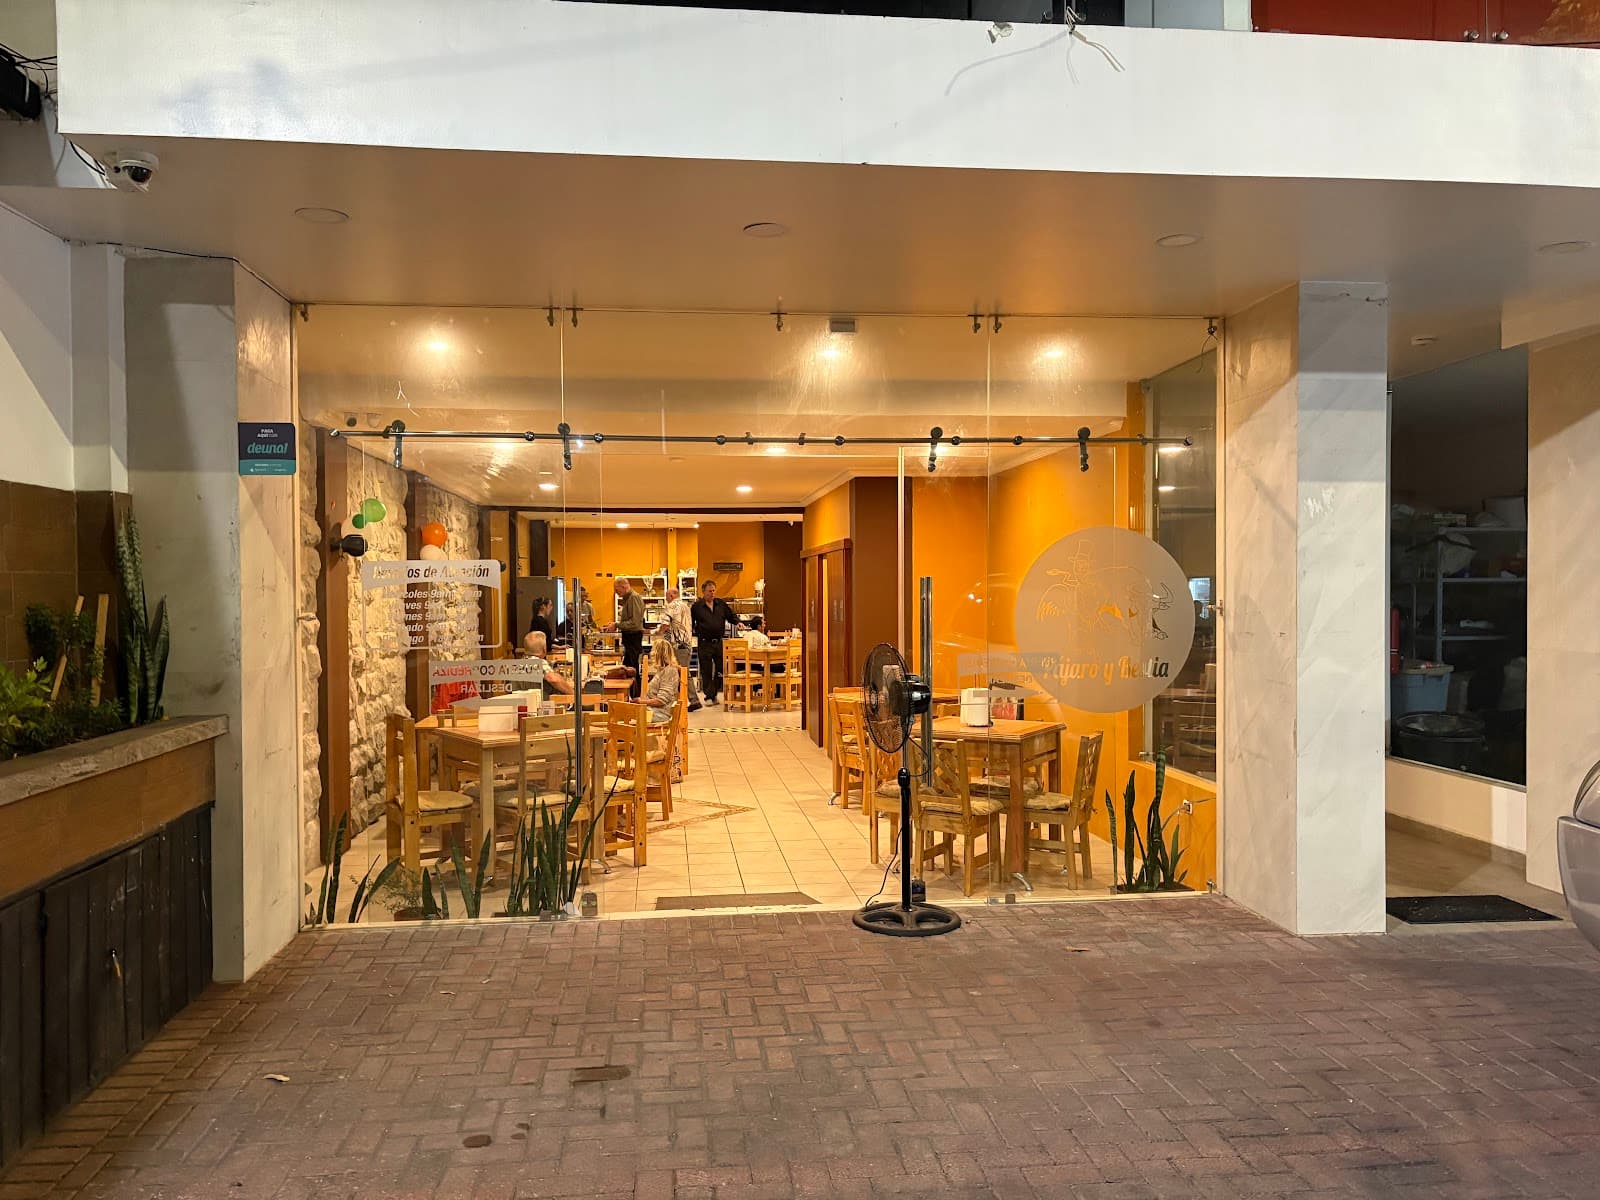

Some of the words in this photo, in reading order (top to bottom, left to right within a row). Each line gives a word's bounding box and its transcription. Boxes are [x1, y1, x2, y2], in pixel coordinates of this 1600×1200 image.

[424, 565, 437, 578] de
[440, 564, 489, 578] Atción
[1103, 662, 1114, 687] y
